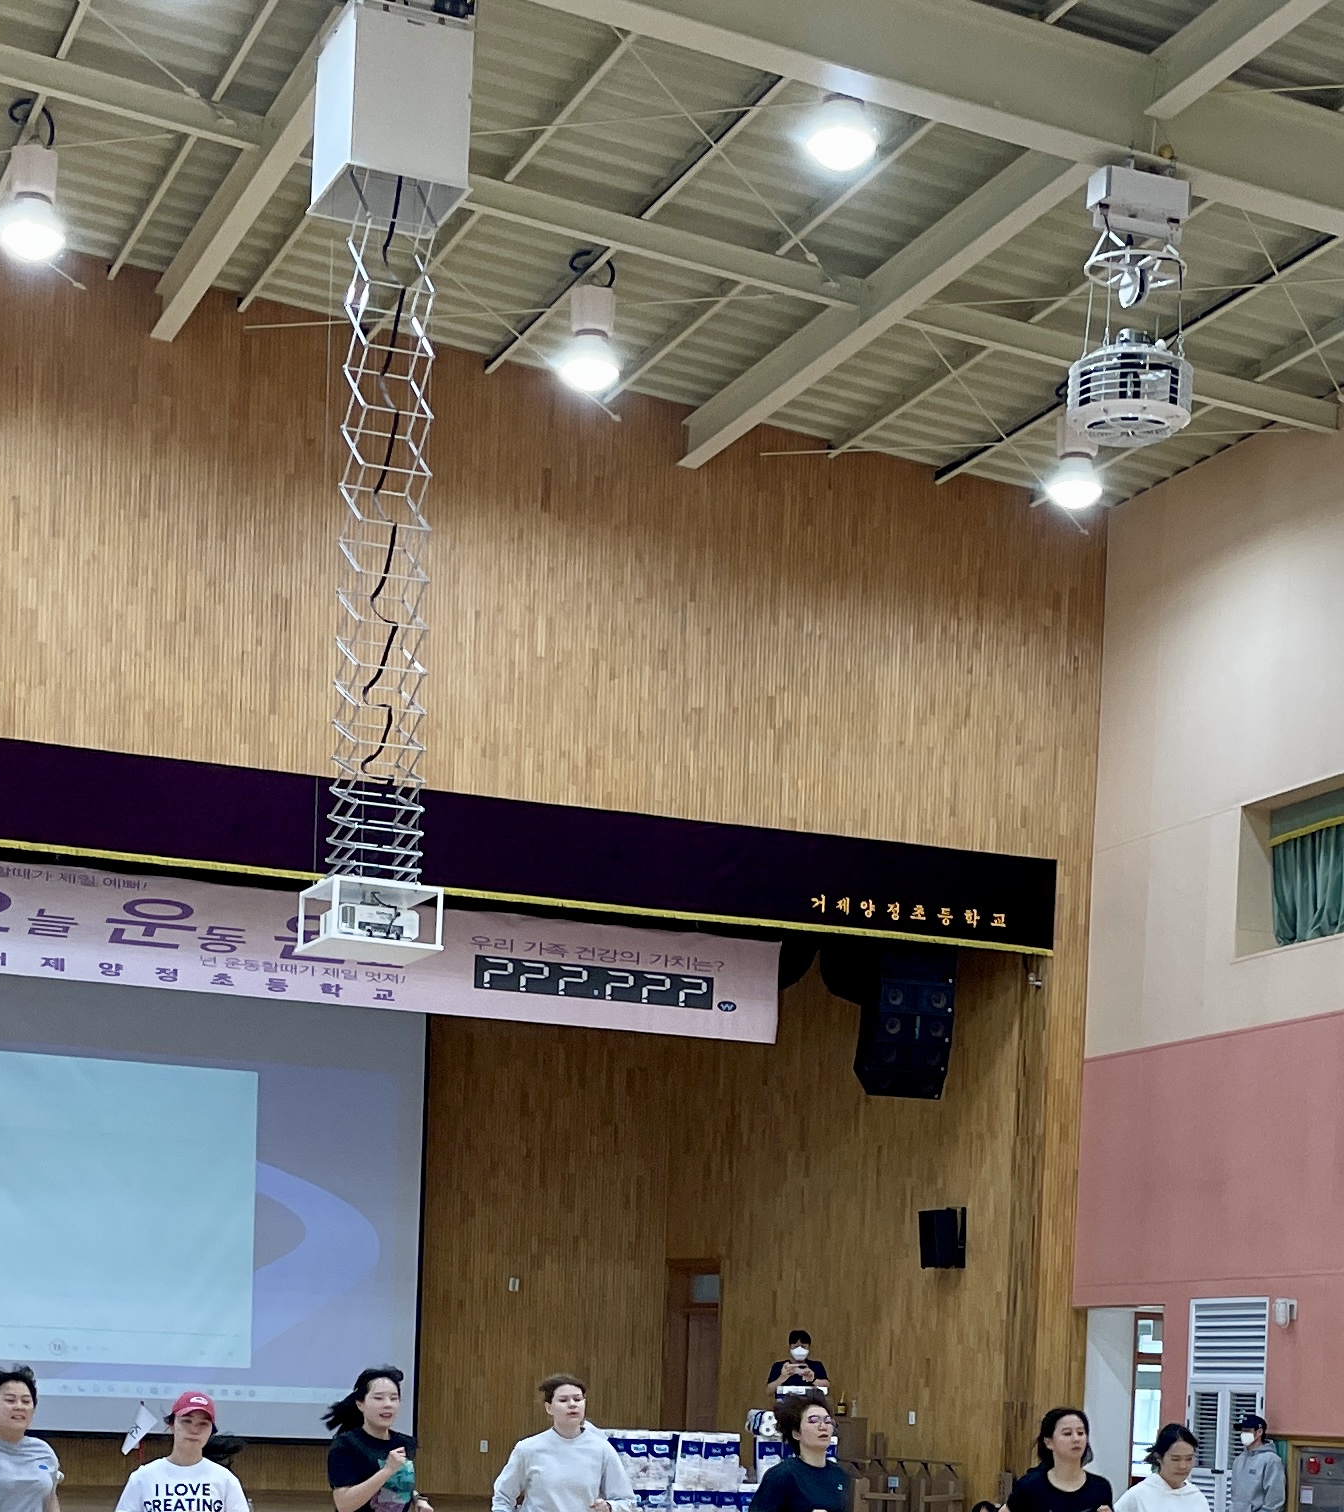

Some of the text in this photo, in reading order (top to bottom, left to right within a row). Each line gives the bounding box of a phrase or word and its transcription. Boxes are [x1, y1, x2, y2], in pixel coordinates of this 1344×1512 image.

[58, 872, 96, 888] 제일
[106, 898, 247, 953] 운동
[470, 934, 725, 974] 우리 가족 건강의 가치는?
[321, 968, 359, 982] 제일
[155, 1482, 211, 1497] I LOVE
